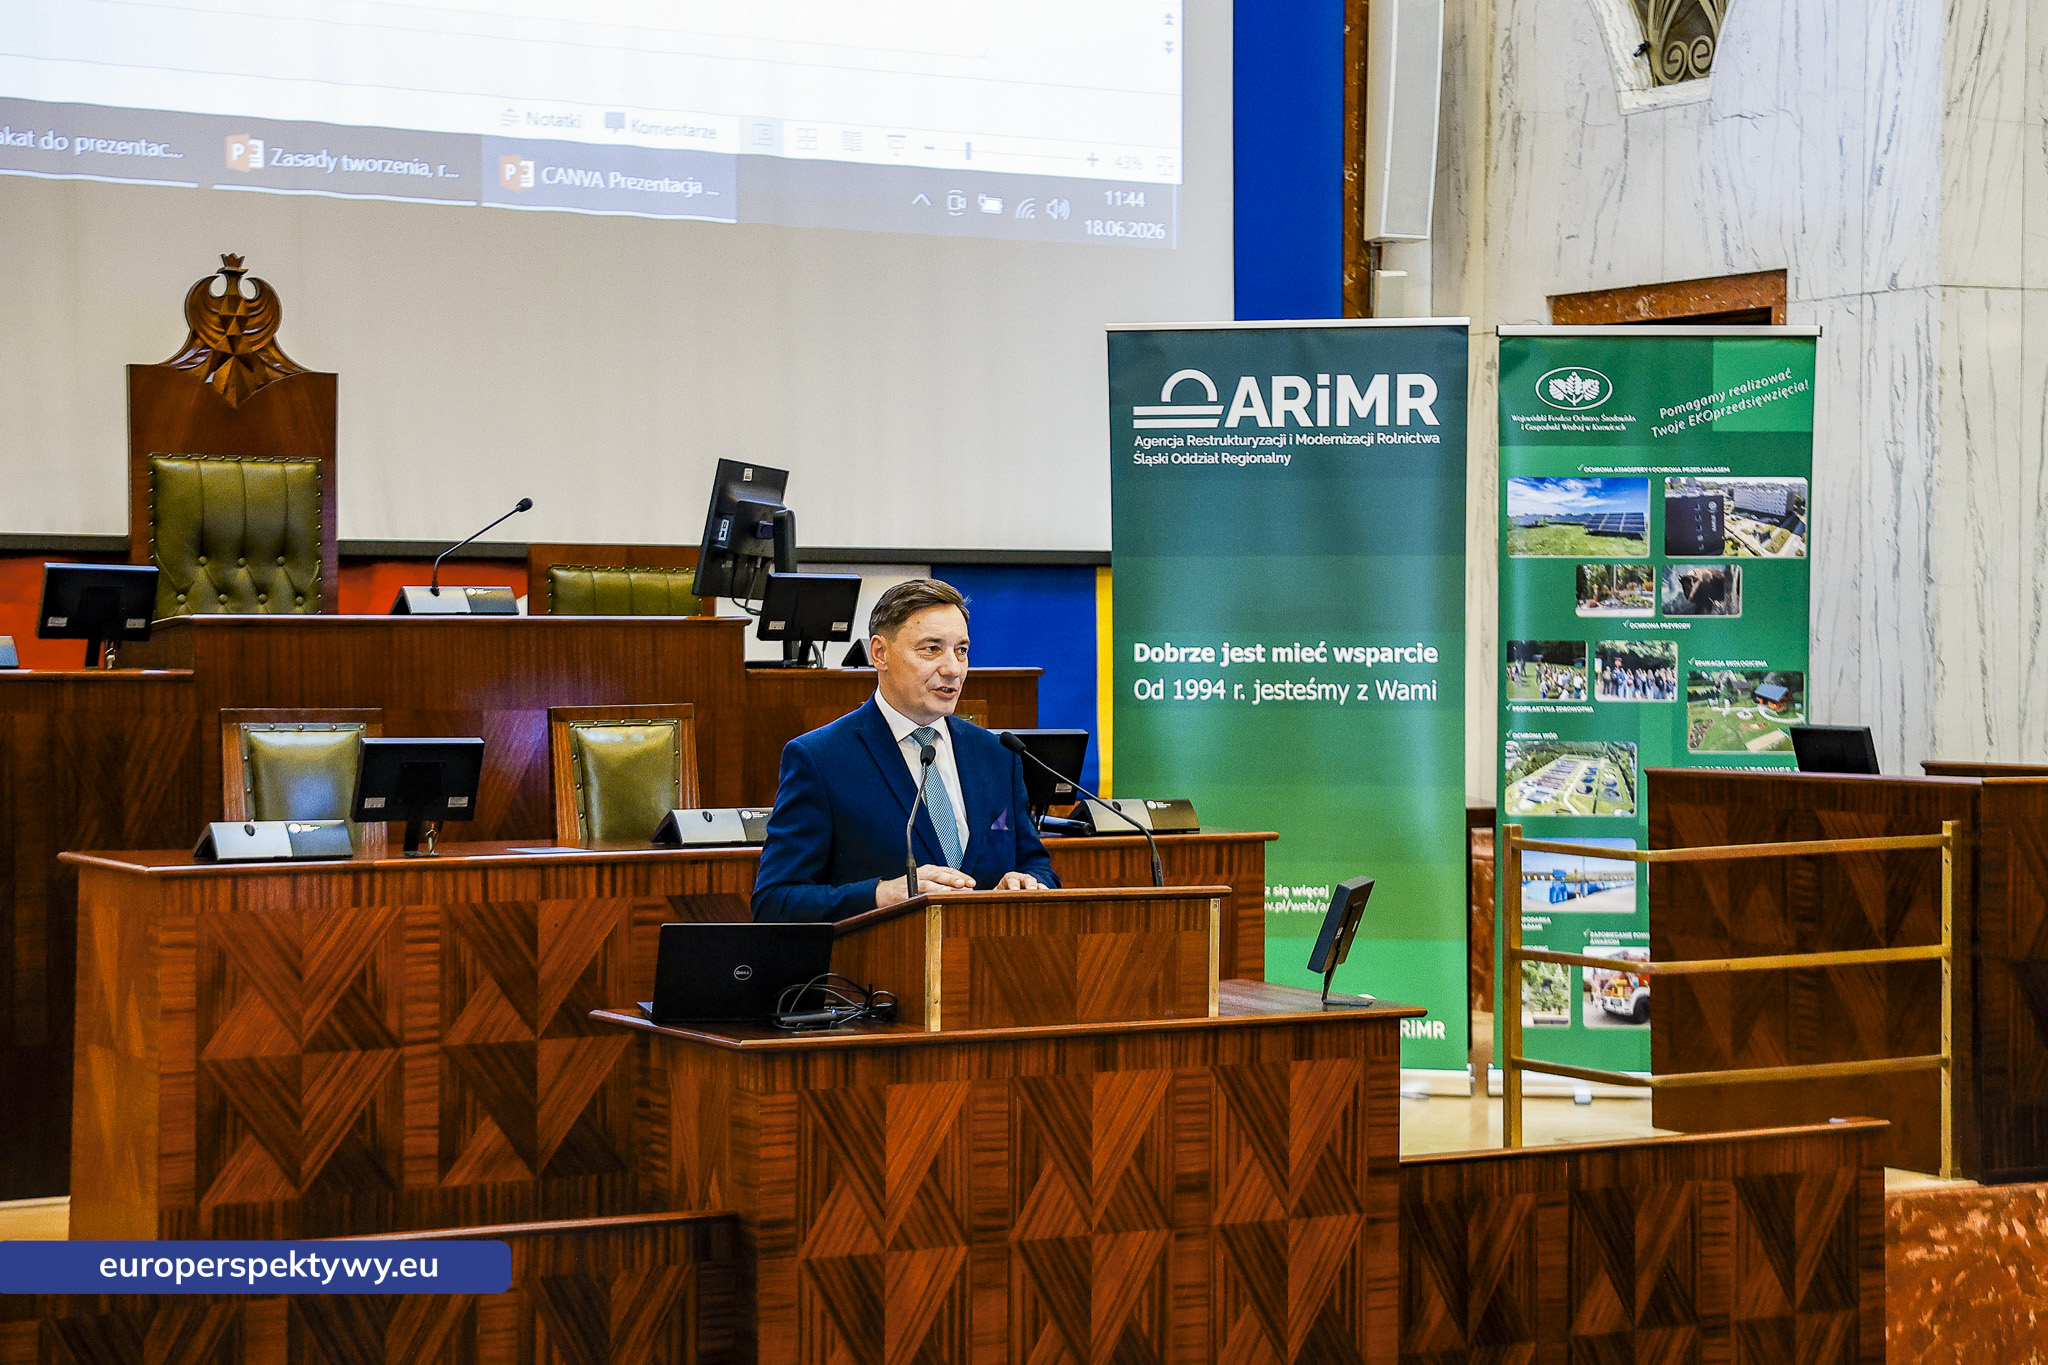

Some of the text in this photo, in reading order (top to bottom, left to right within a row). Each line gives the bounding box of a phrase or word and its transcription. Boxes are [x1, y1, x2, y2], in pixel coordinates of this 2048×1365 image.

[526, 112, 582, 128] Notatki
[631, 119, 718, 140] Komentarze
[40, 130, 70, 150] do
[270, 147, 338, 174] Zasady
[341, 154, 434, 178] tworzenia,
[541, 166, 606, 188] CANVA
[608, 171, 703, 198] Prezentacja
[1104, 190, 1146, 208] 11:44
[1085, 219, 1167, 240] 18.06.2026
[1224, 373, 1440, 428] ARiMR
[1659, 367, 1792, 420] Pomagamy realizować
[1650, 378, 1810, 438] Twoje EKOprzedsięwzięcia!
[1134, 432, 1440, 449] Agencja Restrukturyzacji i Modernizacji Rolnictwa
[1133, 450, 1292, 466] Śląski Oddział Regionalny
[1134, 642, 1438, 668] Dobrze jest mieć wsparcie
[1134, 678, 1438, 705] Od 1994 r. jesteśmy z Wami
[1272, 884, 1290, 898] się
[1292, 884, 1330, 900] więcej
[1400, 1020, 1446, 1040] RiMR
